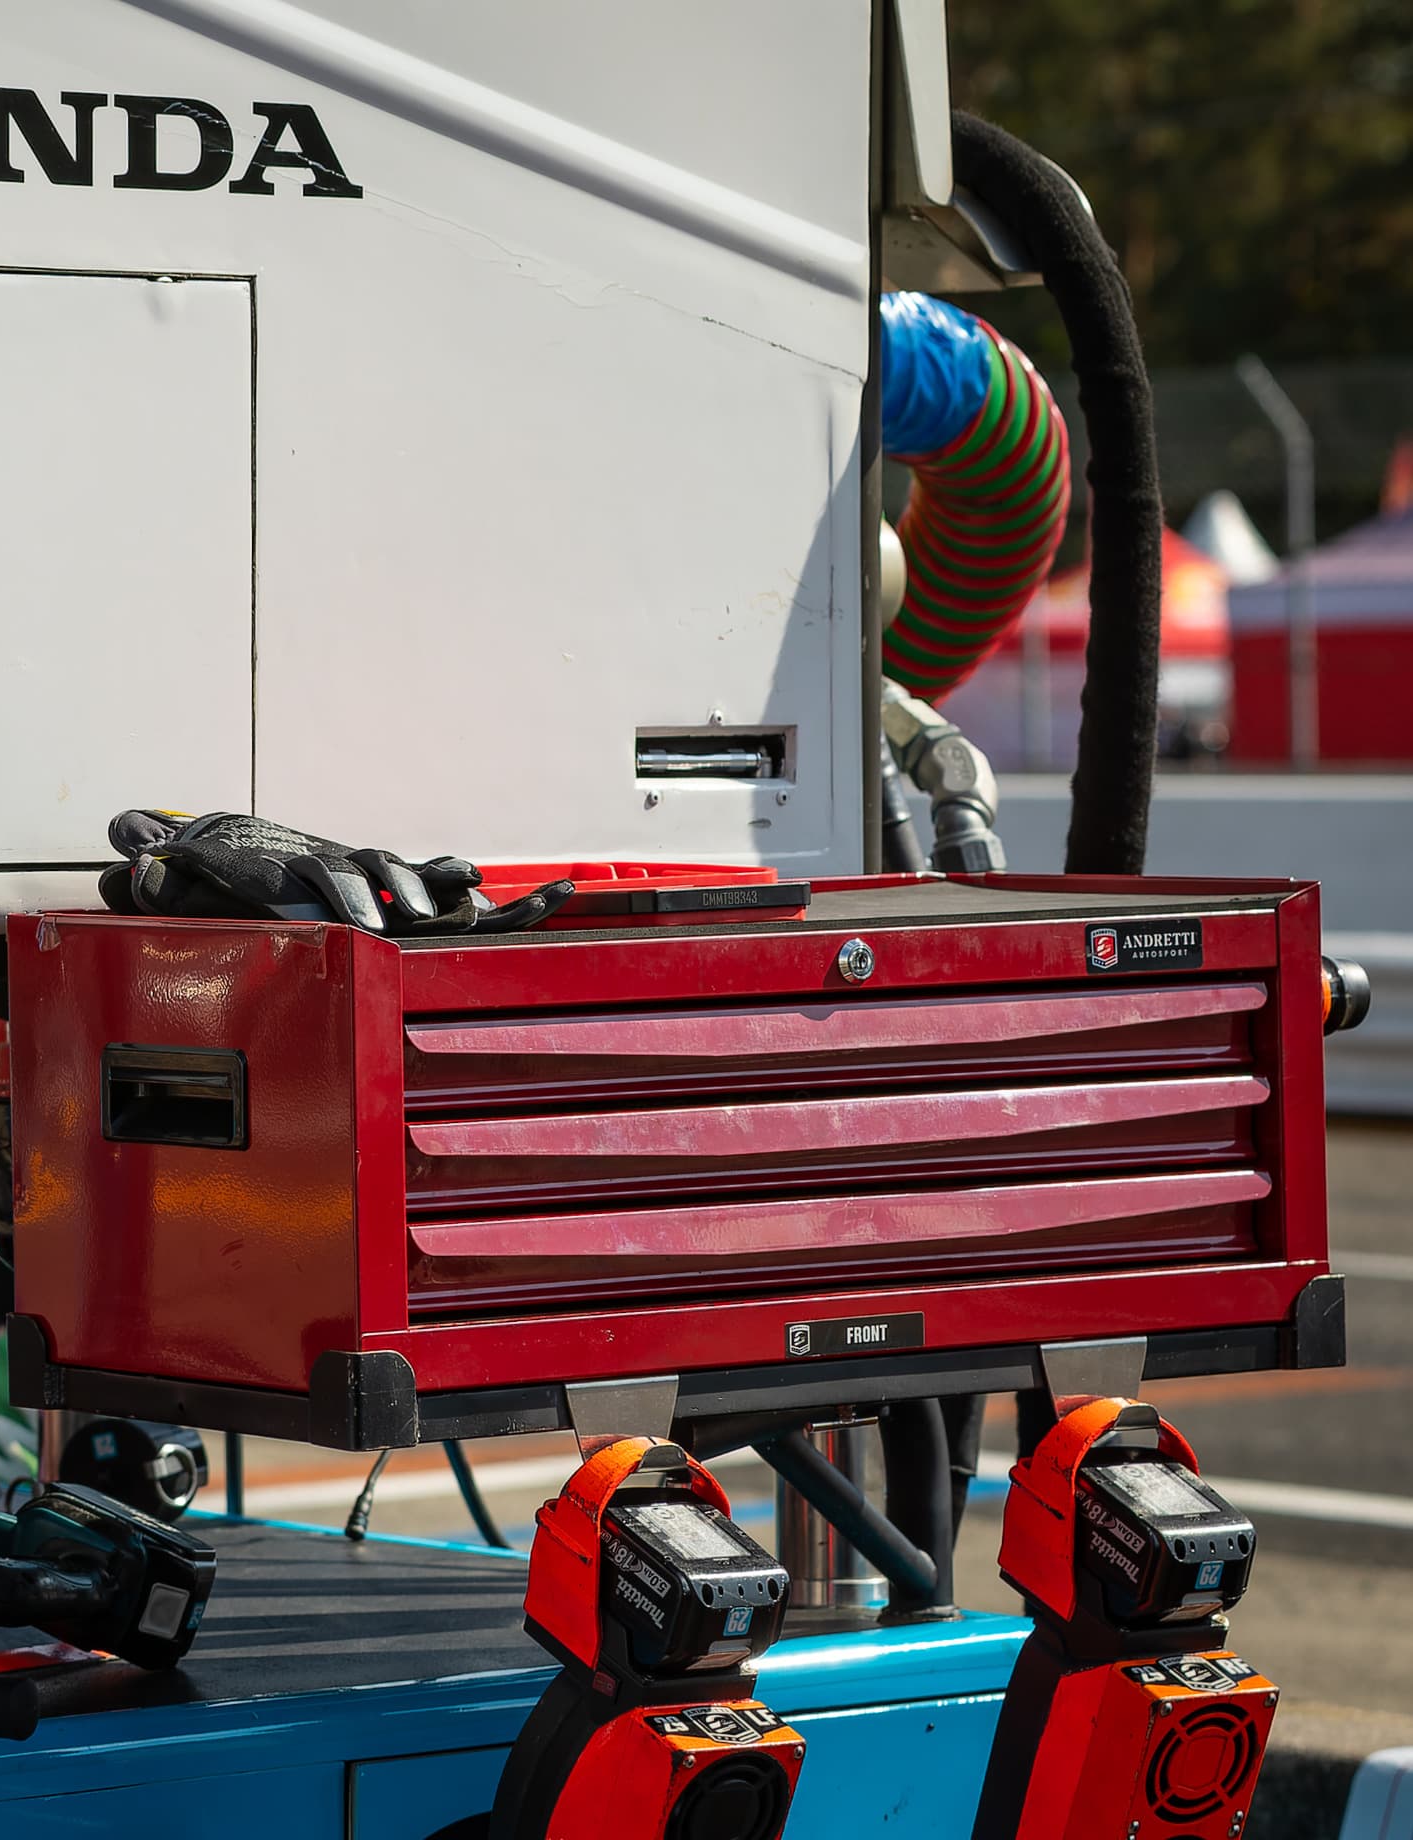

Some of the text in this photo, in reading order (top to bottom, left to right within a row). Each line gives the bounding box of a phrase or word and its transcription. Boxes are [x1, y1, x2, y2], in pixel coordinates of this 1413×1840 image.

[1123, 932, 1195, 949] ANDRETTI
[1132, 949, 1188, 959] AUTOSPORT
[846, 1324, 888, 1344] FRONT
[1199, 1563, 1219, 1585] 29
[729, 1610, 748, 1632] 29
[1216, 1658, 1253, 1675] RF
[743, 1708, 780, 1727] LF
